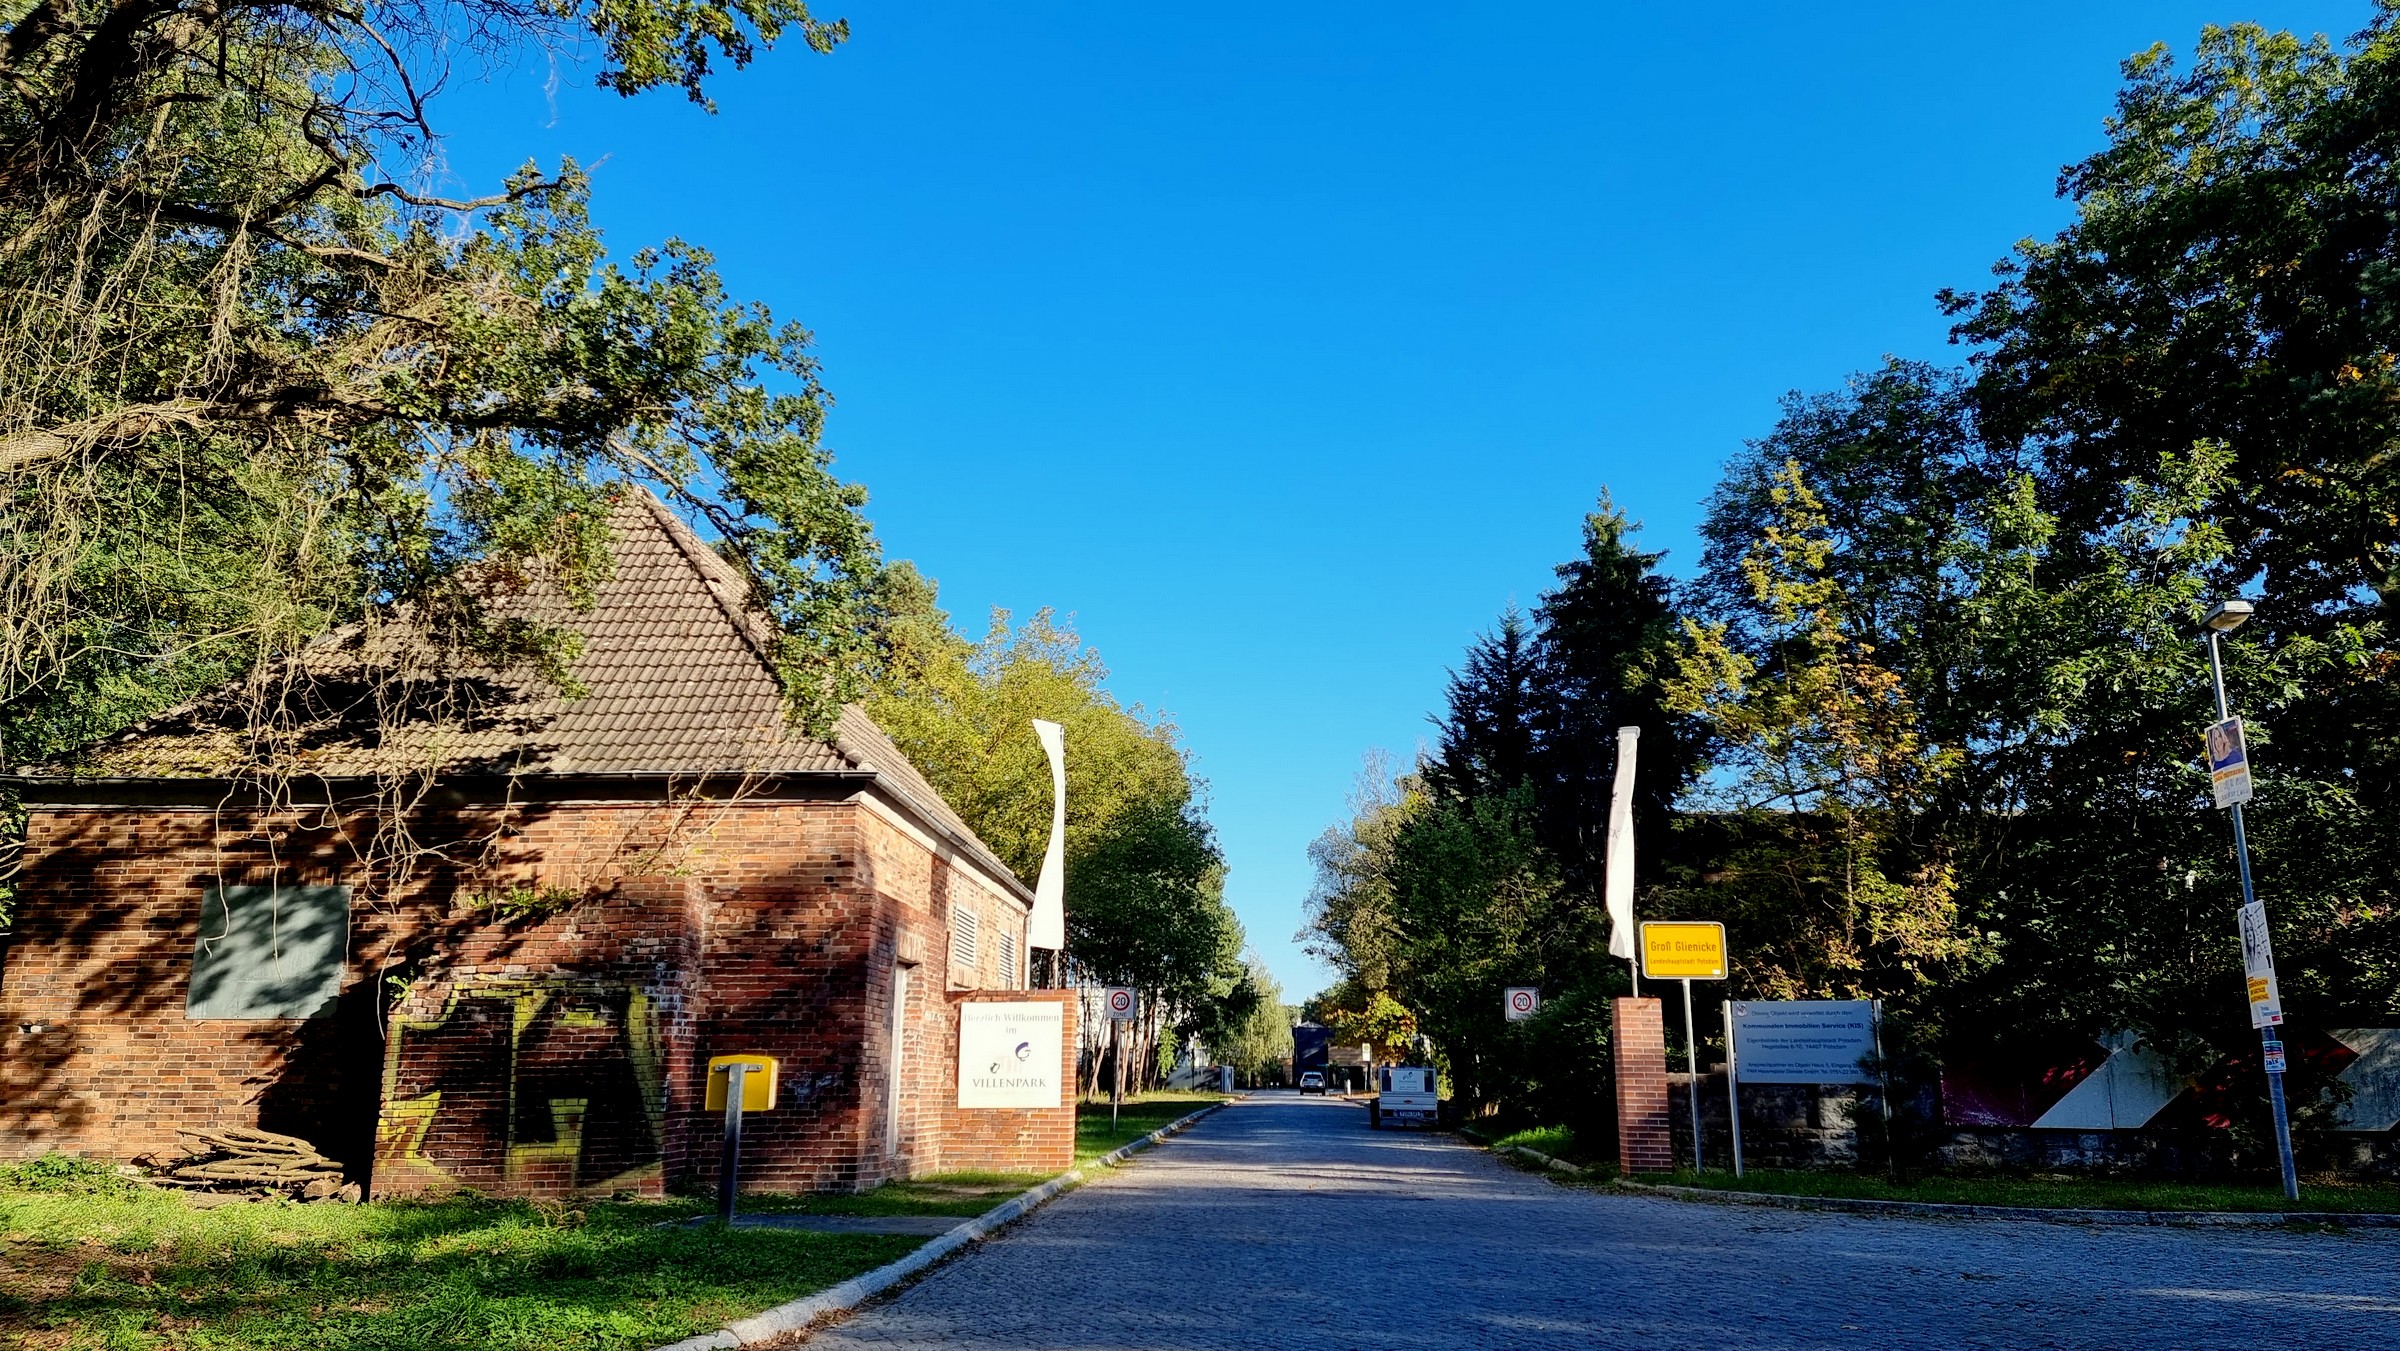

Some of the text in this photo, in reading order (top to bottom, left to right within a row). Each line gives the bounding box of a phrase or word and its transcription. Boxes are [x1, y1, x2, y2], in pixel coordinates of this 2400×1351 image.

[1651, 941, 1716, 952] Groß Glienicke
[1115, 996, 1126, 1006] 20
[1517, 997, 1528, 1007] 20
[963, 1013, 1060, 1023] Herzlich Willkommen
[1005, 1026, 1017, 1034] im
[1847, 1022, 1864, 1030] (KIS)
[972, 1078, 1047, 1088] VILLENPARK
